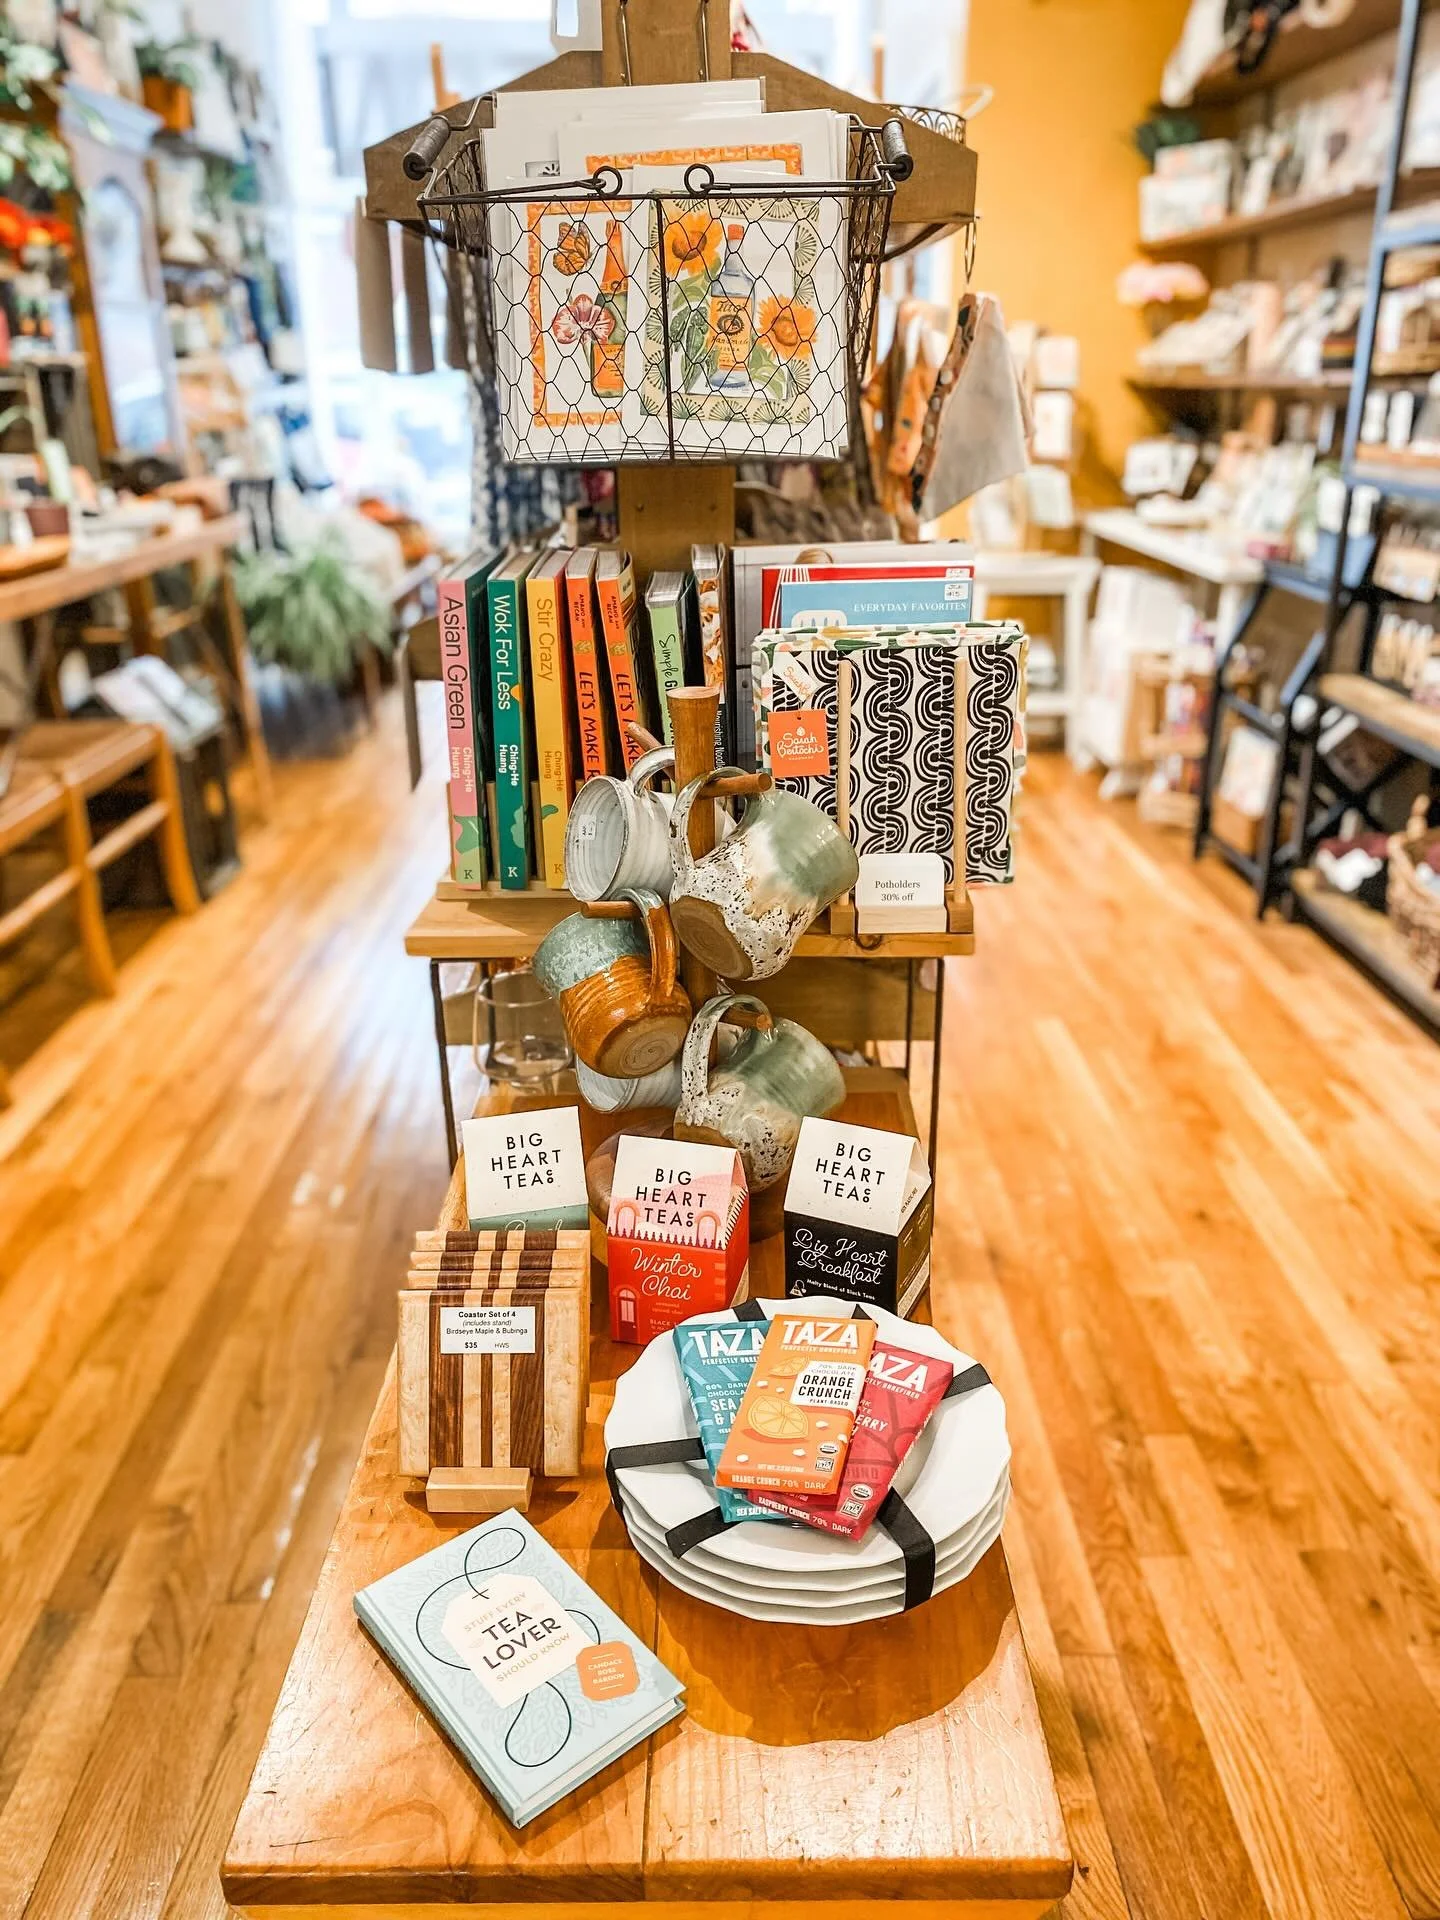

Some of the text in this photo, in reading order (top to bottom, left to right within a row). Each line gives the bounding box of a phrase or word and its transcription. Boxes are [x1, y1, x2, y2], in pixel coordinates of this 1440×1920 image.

[853, 602, 967, 612] EVERYDAY FAVORITES
[494, 595, 513, 710] Wok For Less
[537, 599, 555, 681] Stir Crazy
[444, 597, 469, 729] Asian Green
[659, 634, 679, 678] Simple
[579, 672, 596, 710] LET'S
[616, 674, 640, 766] LET'S AKE
[583, 717, 600, 763] MAKE
[776, 741, 825, 758] Bertochi
[783, 732, 817, 748] Sarah
[452, 747, 461, 779] Huang
[463, 747, 475, 793] Ching-He
[499, 744, 508, 774] Huang
[509, 744, 520, 786] Ching-He
[544, 751, 552, 779] Huang
[554, 751, 564, 792] Ching-He
[463, 869, 474, 880] K
[508, 867, 518, 877] K
[554, 864, 564, 874] K
[875, 880, 921, 889] Potholders
[881, 893, 914, 902] 30% off
[506, 1133, 543, 1150] BIG
[836, 1142, 872, 1162] BIG
[491, 1149, 561, 1172] HEART
[815, 1158, 885, 1185] HEART
[503, 1172, 544, 1189] TEA
[655, 1168, 692, 1185] BIG
[636, 1186, 707, 1208] HEART
[823, 1179, 859, 1202] TEA
[644, 1207, 683, 1227] TEA
[792, 1228, 832, 1261] Big
[835, 1238, 889, 1267] Heart
[630, 1247, 702, 1278] Winter
[797, 1249, 883, 1285] Breakfast
[641, 1275, 692, 1301] Chai
[823, 1282, 838, 1291] Blend
[846, 1289, 861, 1297] Black
[502, 1328, 528, 1336] Bubinga
[688, 1328, 766, 1358] TAZA
[782, 1320, 859, 1349] TAZA
[702, 1357, 738, 1366] PERFECTLY
[870, 1352, 928, 1393] AZA
[798, 1385, 851, 1400] CRUNCH
[802, 1374, 855, 1388] ORANGE
[710, 1397, 737, 1412] SEA
[855, 1414, 888, 1432] ERRY
[731, 1474, 827, 1489] ORANGE CRUNCH 70% DARK
[736, 1507, 748, 1517] SEA
[748, 1507, 761, 1516] SALT
[758, 1496, 789, 1513] RASPBERRY
[788, 1506, 810, 1520] CRUNCH
[812, 1515, 828, 1527] 70%
[832, 1523, 853, 1535] DARK
[464, 1592, 526, 1632] STUFF EVERY
[481, 1611, 533, 1641] TEA
[482, 1617, 562, 1670] LOVER
[496, 1632, 570, 1682] SHOULD KNOW
